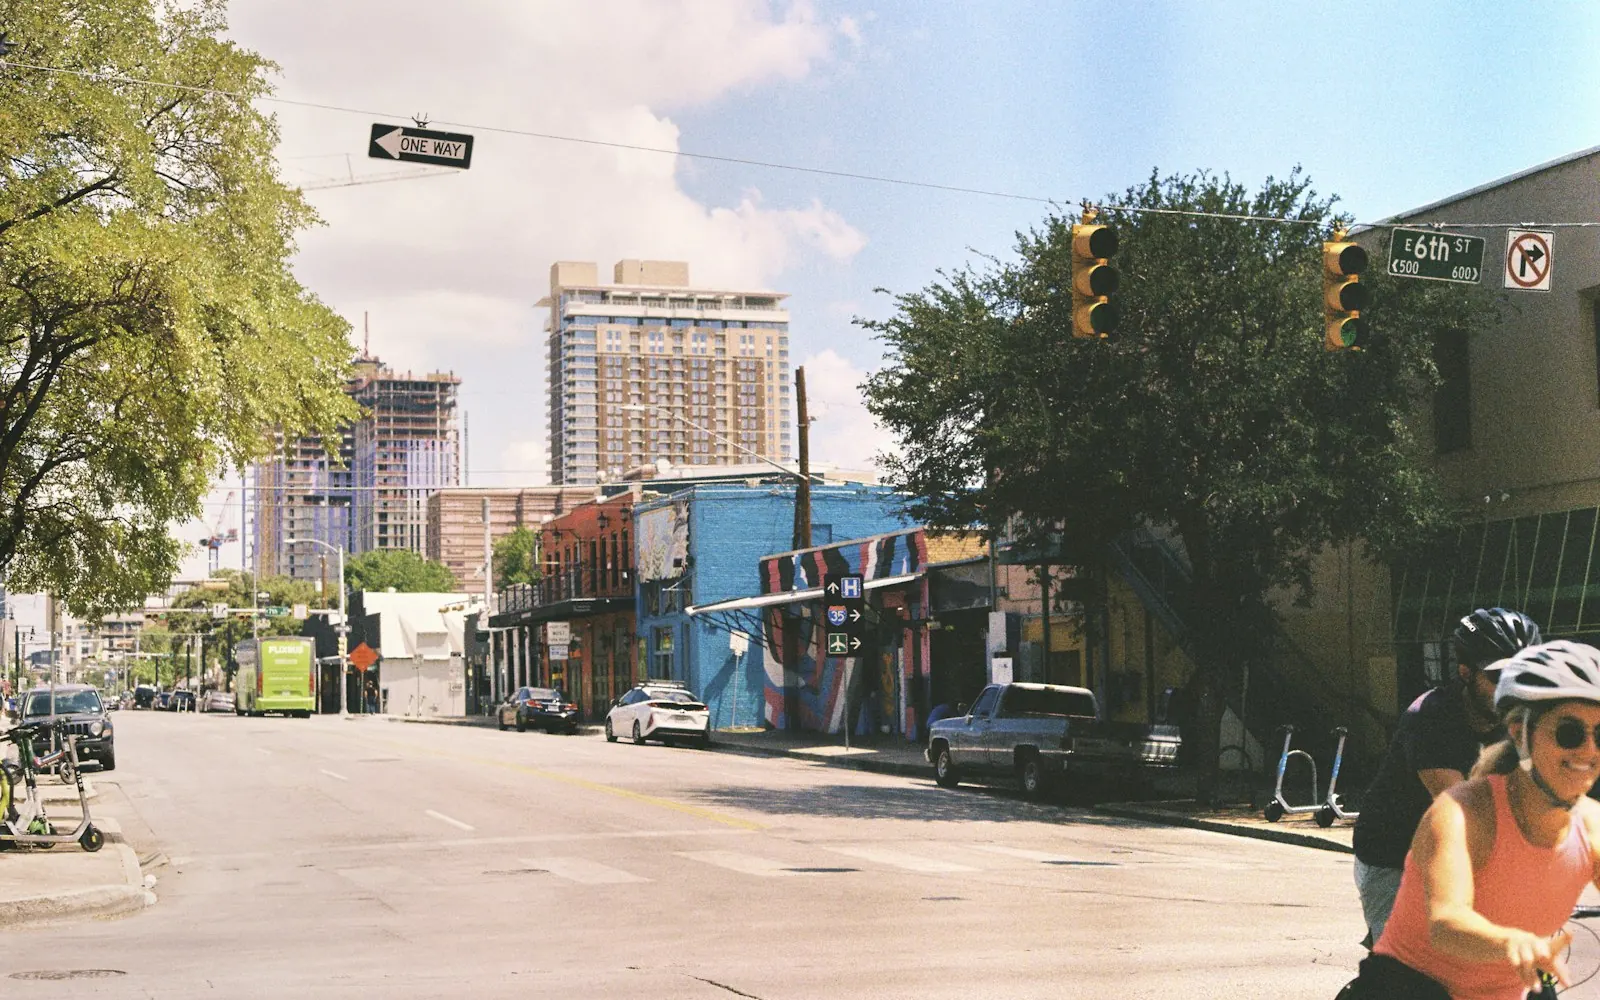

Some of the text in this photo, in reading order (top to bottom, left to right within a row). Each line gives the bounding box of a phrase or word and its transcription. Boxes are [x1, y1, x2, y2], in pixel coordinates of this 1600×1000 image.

[401, 138, 461, 157] ONE WAY
[1405, 234, 1471, 262] E 6th ST
[1399, 260, 1472, 280] 500 600
[844, 579, 857, 596] H
[831, 610, 845, 622] 35
